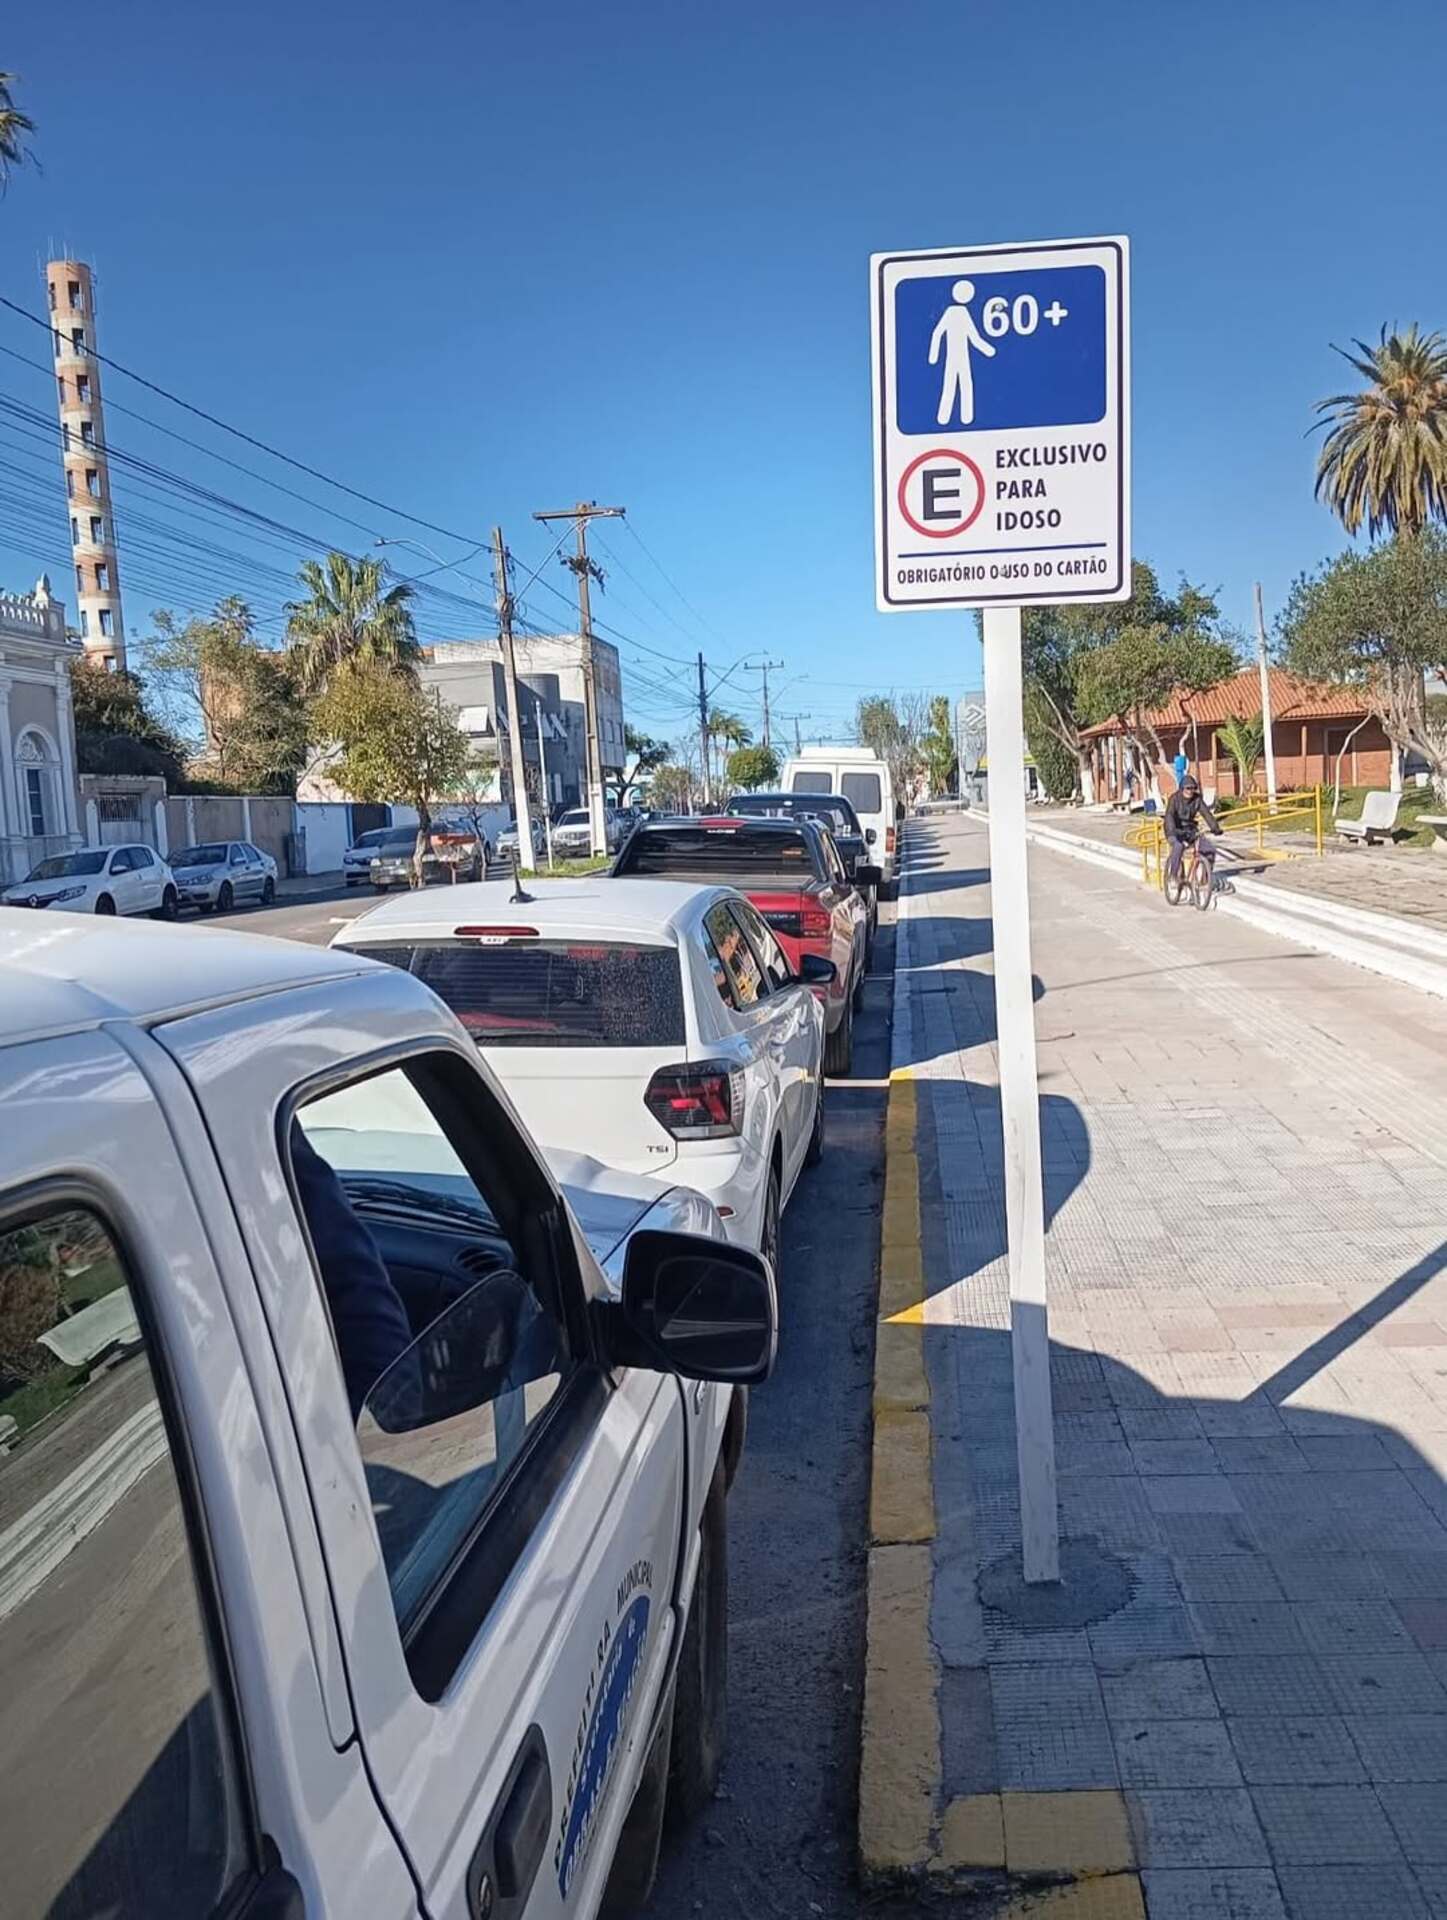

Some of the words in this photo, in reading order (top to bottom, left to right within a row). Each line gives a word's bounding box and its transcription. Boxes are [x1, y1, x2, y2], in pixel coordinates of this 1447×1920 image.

[983, 294, 1068, 337] 60+
[996, 443, 1107, 469] EXCLUSIVO
[923, 468, 962, 521] E
[996, 478, 1047, 500] PARA
[997, 509, 1062, 531] IDOSO
[898, 562, 986, 585] OBRIGATÓRIO
[990, 565, 1000, 579] O
[1034, 561, 1053, 577] DO
[1057, 555, 1107, 576] CARTÃO
